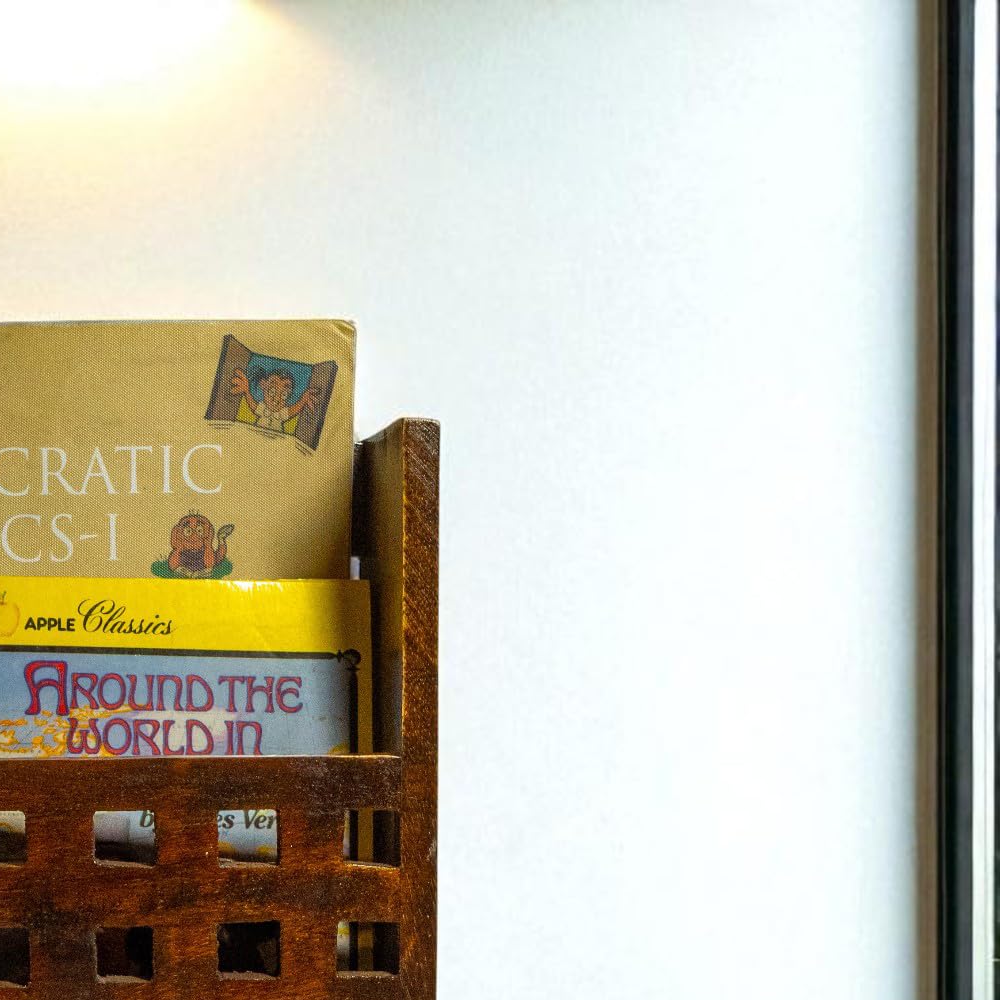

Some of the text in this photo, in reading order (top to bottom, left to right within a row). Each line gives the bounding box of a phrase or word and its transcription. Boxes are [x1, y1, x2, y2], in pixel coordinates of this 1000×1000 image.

[24, 599, 173, 635] APPLE Classics
[23, 660, 304, 717] AROUND THE
[66, 716, 264, 756] WORLD IN
